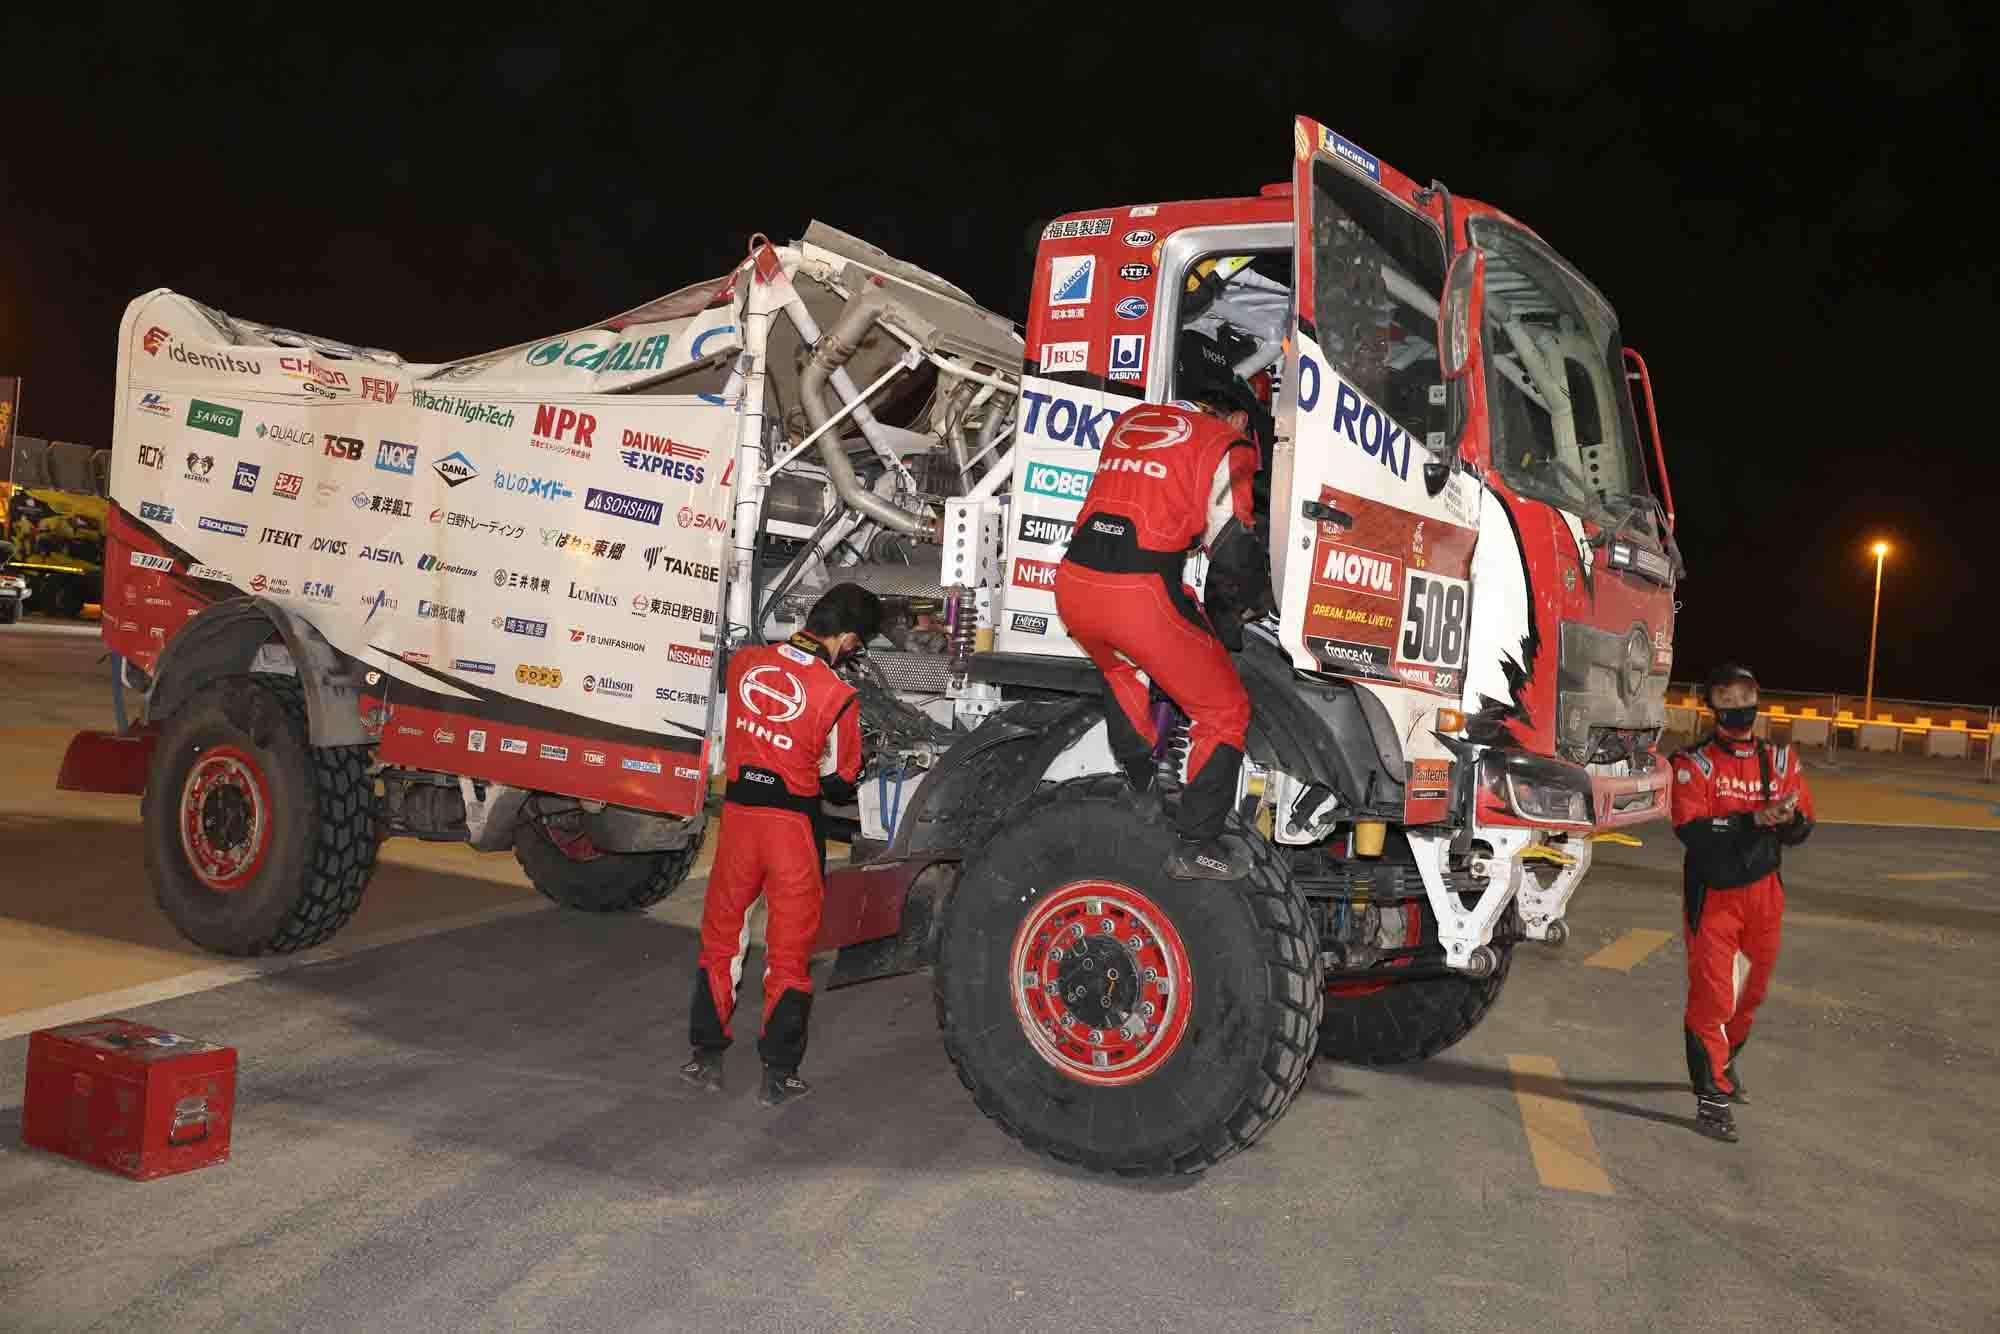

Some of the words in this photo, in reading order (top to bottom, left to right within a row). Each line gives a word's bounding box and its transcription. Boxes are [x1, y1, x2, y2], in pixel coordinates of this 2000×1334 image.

[1336, 143, 1376, 172] MICHELIN
[1125, 232, 1152, 242] Arai
[168, 339, 261, 375] idemitsu
[1109, 372, 1140, 381] KASUYA
[303, 382, 337, 400] Group
[361, 376, 399, 404] FEV
[195, 410, 234, 427] SANGO
[412, 390, 453, 414] Hitachi
[455, 400, 515, 428] High-Tech
[269, 425, 315, 446] QUALICA
[533, 402, 597, 448] NPR
[1333, 381, 1412, 482] ROKI
[622, 429, 673, 456] DAIWA
[380, 444, 415, 469] NOK
[621, 450, 705, 484] EXPRESS
[441, 463, 468, 476] DANA
[494, 470, 574, 500] ねじのメイドー
[603, 494, 659, 522] SOHSHIN
[257, 527, 303, 549] JTEKT
[359, 546, 405, 566] AISIN
[663, 556, 720, 583] TAKEBE
[1322, 550, 1393, 592] MOTUL
[1311, 603, 1345, 620] DREAM.
[1345, 609, 1368, 624] DARE.
[1368, 613, 1384, 626] LIVE
[1402, 575, 1465, 665] 508
[598, 636, 646, 653] UNIFASHION
[519, 670, 560, 683] TOPY
[598, 677, 633, 692] Allison
[656, 687, 677, 702] SSC
[736, 717, 793, 750] HINO
[743, 771, 776, 785] sparco
